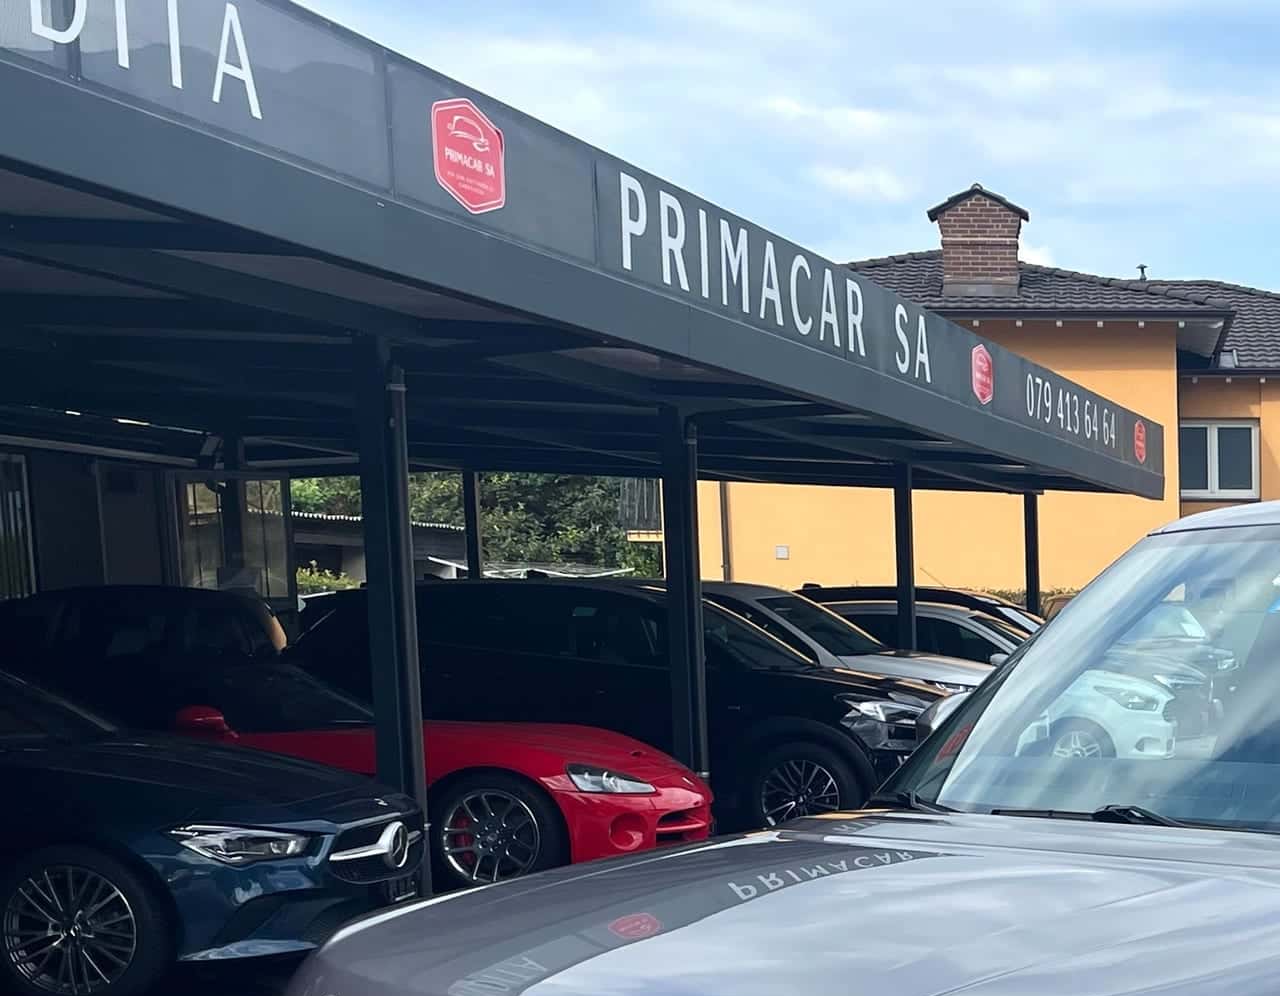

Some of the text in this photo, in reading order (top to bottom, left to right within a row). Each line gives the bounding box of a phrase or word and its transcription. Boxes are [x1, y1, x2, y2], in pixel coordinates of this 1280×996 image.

[620, 171, 932, 384] PRIMACAR SA
[1026, 373, 1116, 449] 079 413 64 64
